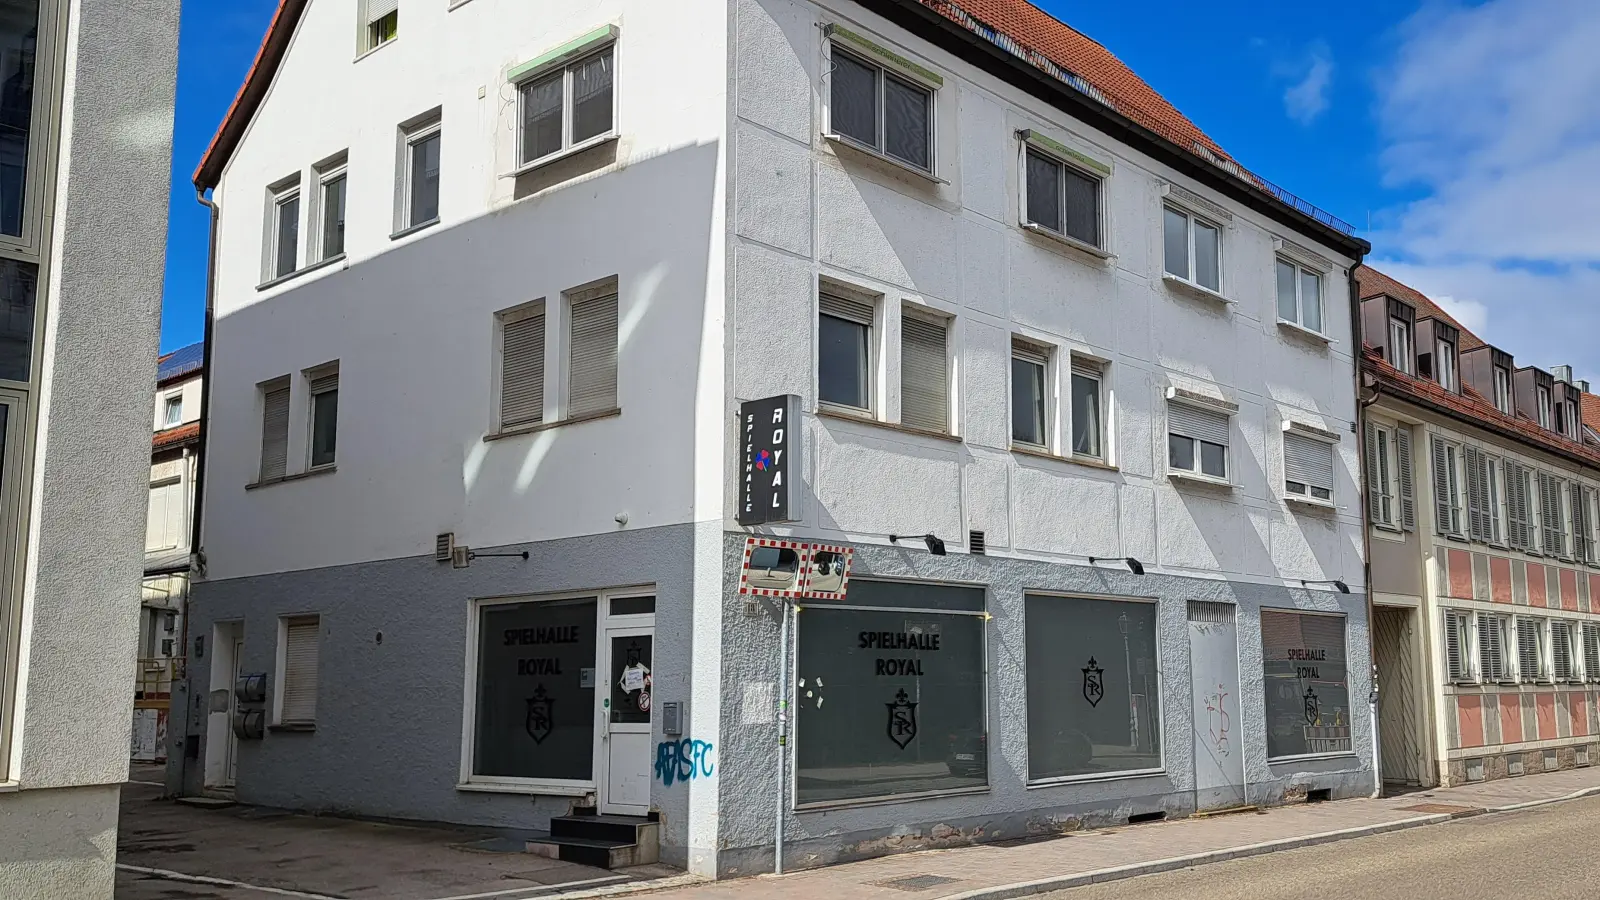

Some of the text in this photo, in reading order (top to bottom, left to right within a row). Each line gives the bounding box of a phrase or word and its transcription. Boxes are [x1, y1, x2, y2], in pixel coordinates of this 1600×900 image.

[745, 414, 754, 512] SPIELHALLE
[771, 407, 784, 508] ROYAL
[504, 626, 580, 646] SPIELHALLE
[858, 631, 940, 650] SPIELHALLE
[1287, 648, 1326, 661] SPIELHALLE
[518, 659, 562, 675] ROYAL
[874, 658, 924, 676] ROYAL
[1297, 667, 1320, 679] ROYAL
